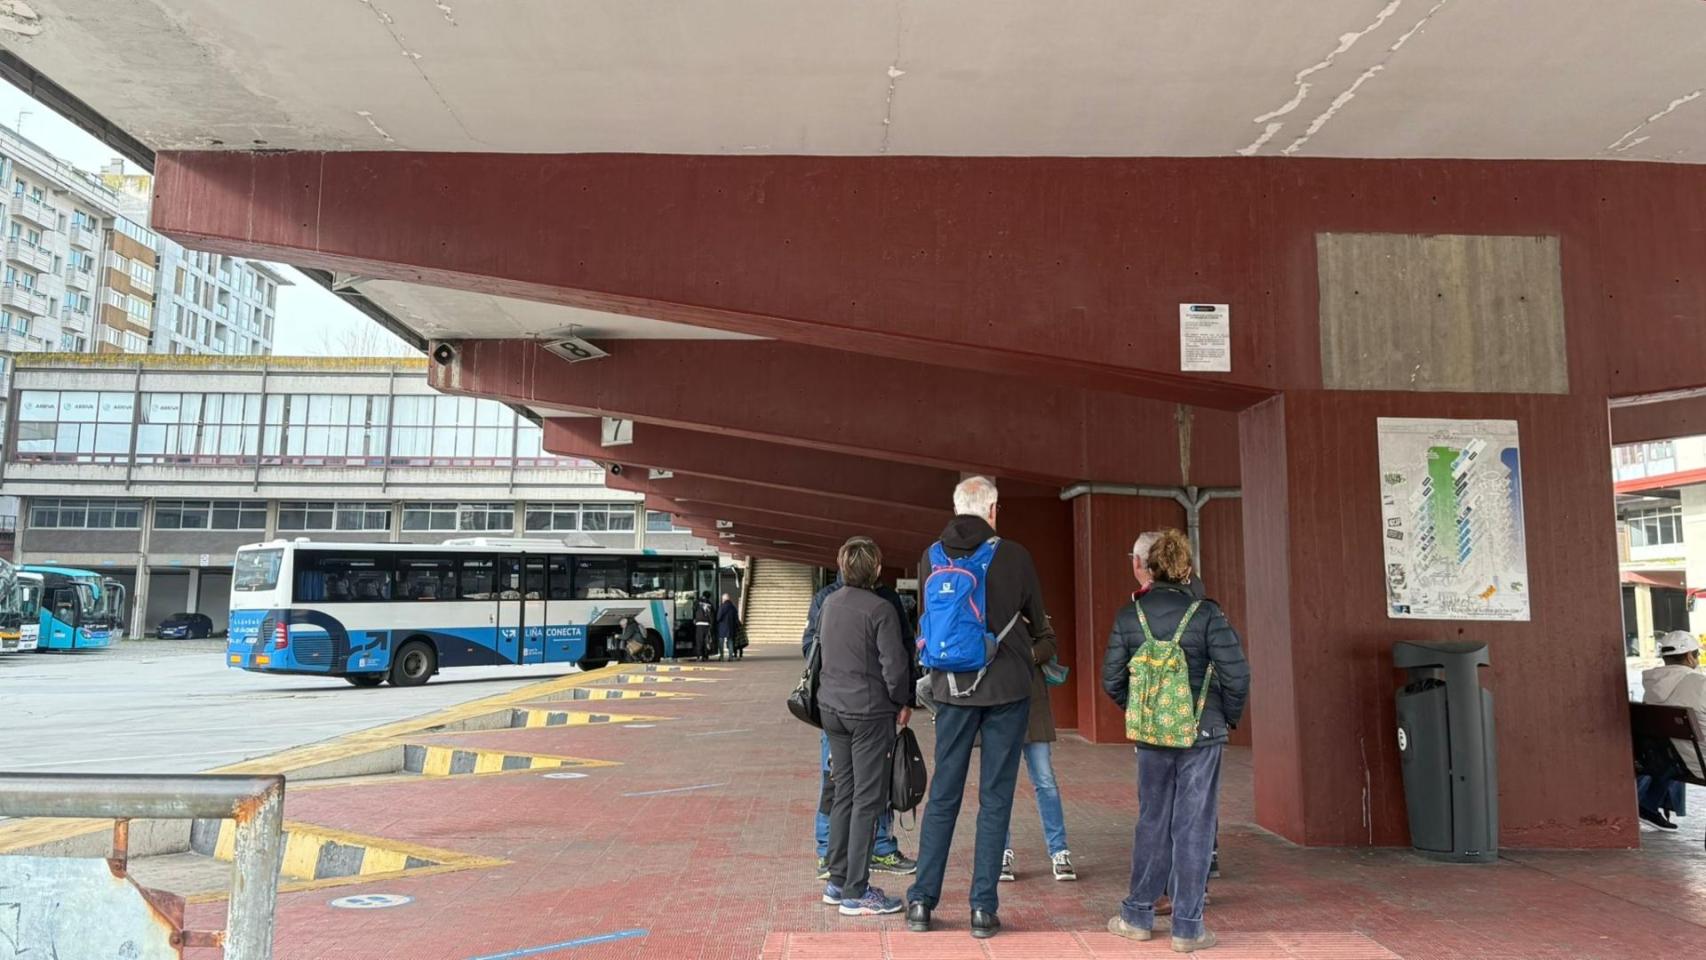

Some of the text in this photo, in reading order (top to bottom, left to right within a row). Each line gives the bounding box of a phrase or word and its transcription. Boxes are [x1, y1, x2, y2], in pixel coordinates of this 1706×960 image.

[560, 342, 591, 357] 8
[611, 418, 623, 441] 7
[525, 626, 582, 637] LIÑA CONECTA
